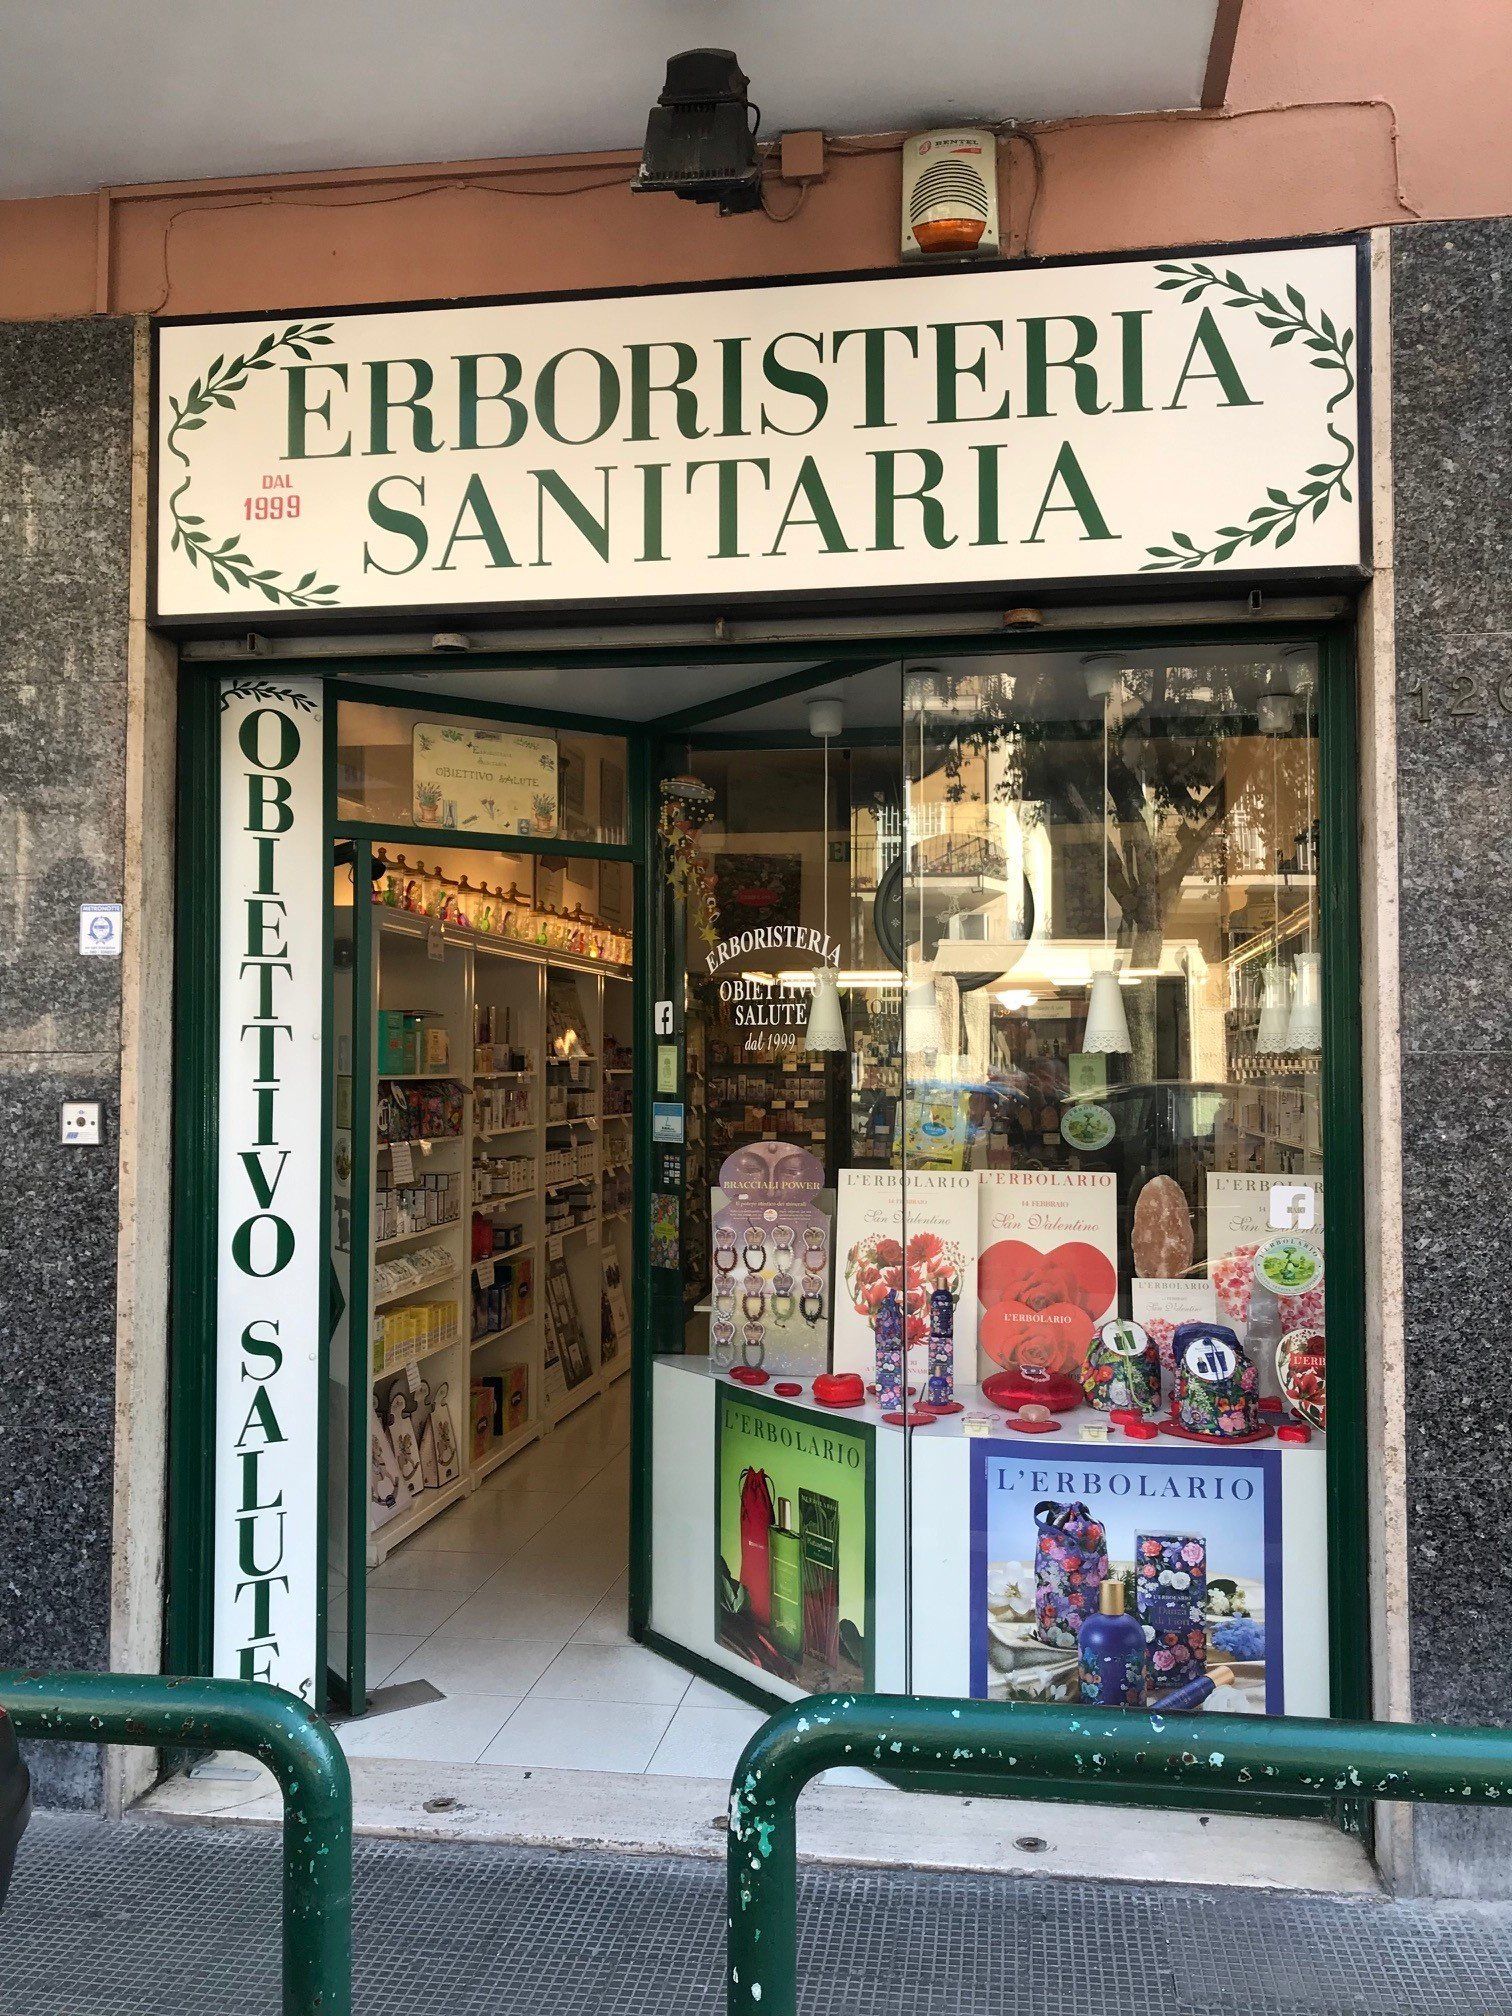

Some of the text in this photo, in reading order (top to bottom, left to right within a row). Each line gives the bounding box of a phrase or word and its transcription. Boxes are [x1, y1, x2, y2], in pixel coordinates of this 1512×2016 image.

[934, 139, 979, 147] BENTEL
[279, 306, 1264, 460] ERBORISTERIA
[261, 474, 294, 490] DAL
[243, 494, 302, 521] 1999
[363, 440, 1122, 575] SANITARIA
[435, 766, 540, 788] OBIETTIVO SALUTE
[704, 925, 841, 975] ERBORISTERIA
[231, 708, 301, 1278] OBIETTIVO
[719, 979, 824, 1002] OBIETTIVO
[735, 1003, 808, 1026] SALUTE
[744, 1030, 796, 1051] dal 1999
[723, 1181, 820, 1190] BRACCIALI POWER
[847, 1174, 970, 1189] L'ERBOLARIO
[979, 1172, 1111, 1187] L'ERBOLARIO
[1031, 1200, 1070, 1208] FEBBRAIO
[864, 1209, 888, 1223] San
[992, 1212, 1101, 1231] San Valentino
[1138, 1281, 1210, 1291] L'ERBOLARIO
[1003, 1313, 1072, 1324] L'ERBOLARIO
[723, 1408, 860, 1470] L'ERBOLARIO
[997, 1468, 1255, 1501] L'ERBOLARIO
